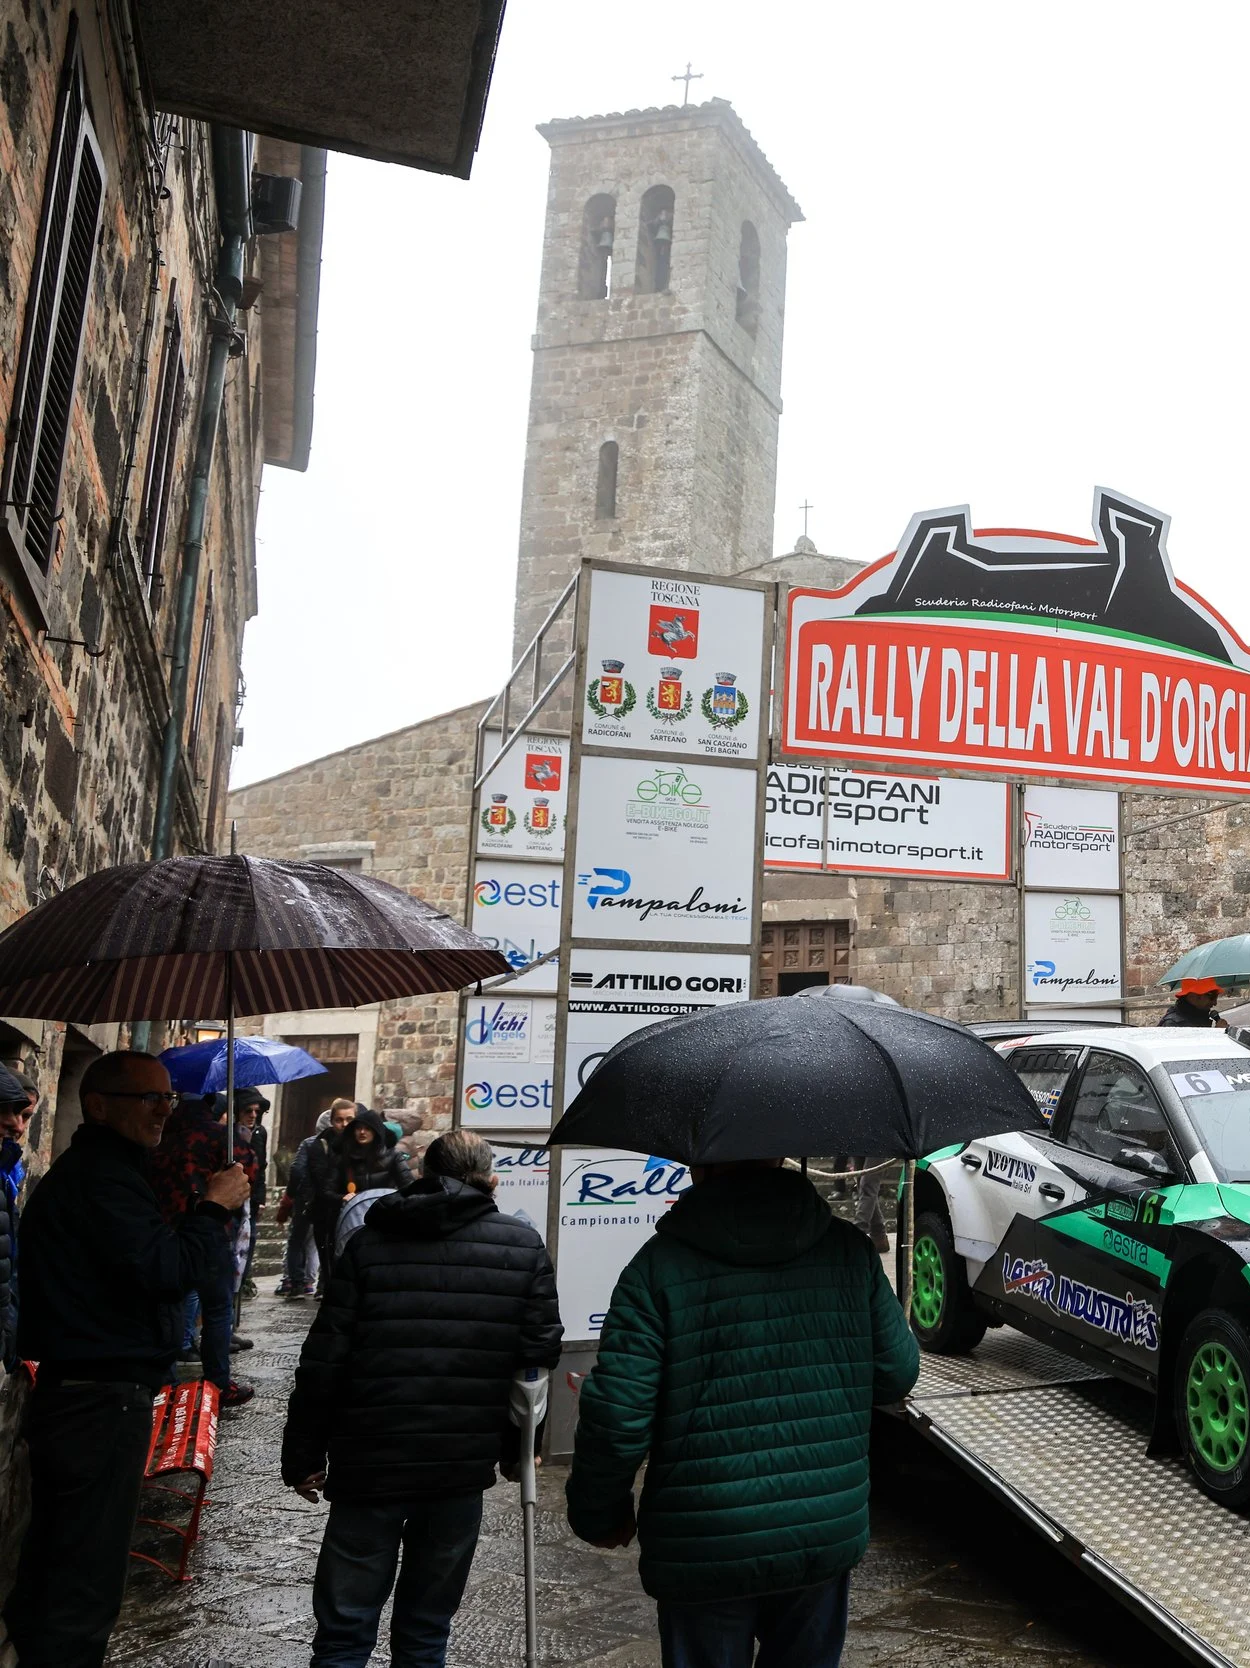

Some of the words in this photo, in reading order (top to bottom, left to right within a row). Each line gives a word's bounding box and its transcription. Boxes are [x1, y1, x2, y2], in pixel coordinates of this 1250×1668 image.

[651, 580, 700, 596] REGIONE
[651, 591, 700, 607] TOSCANA
[915, 596, 968, 609] Scuderia
[971, 597, 1036, 612] Radicofani
[1038, 603, 1098, 621] Motorsport
[808, 643, 931, 741] RALLY
[939, 647, 1053, 754] DELLA
[1061, 658, 1130, 759] VAL
[588, 728, 631, 739] RADICOFANI
[594, 722, 619, 731] COMUNE
[653, 727, 677, 736] COMUNE
[527, 736, 563, 746] REGIONE
[650, 734, 687, 744] SARTEANO
[698, 738, 713, 747] SAN
[713, 739, 747, 749] CASCIANO
[527, 744, 562, 754] TOSCANA
[706, 745, 718, 753] DEI
[719, 746, 739, 755] BAGNI
[1043, 823, 1078, 831] Scuderia
[1034, 830, 1115, 843] RADICOFANI
[1030, 840, 1111, 852] motorsport
[588, 867, 746, 921] Pampaloni
[593, 973, 682, 991] ATTILIO
[686, 976, 742, 993] GORI
[1033, 961, 1118, 992] Pampaloni
[1187, 1073, 1212, 1094] 6
[983, 1150, 1038, 1184] NEOTENS
[1012, 1178, 1024, 1191] Italia
[1024, 1183, 1032, 1194] Srl
[561, 1215, 640, 1228] Campionato
[1114, 1233, 1149, 1265] estra
[1057, 1275, 1159, 1351] INDUSTRIES
